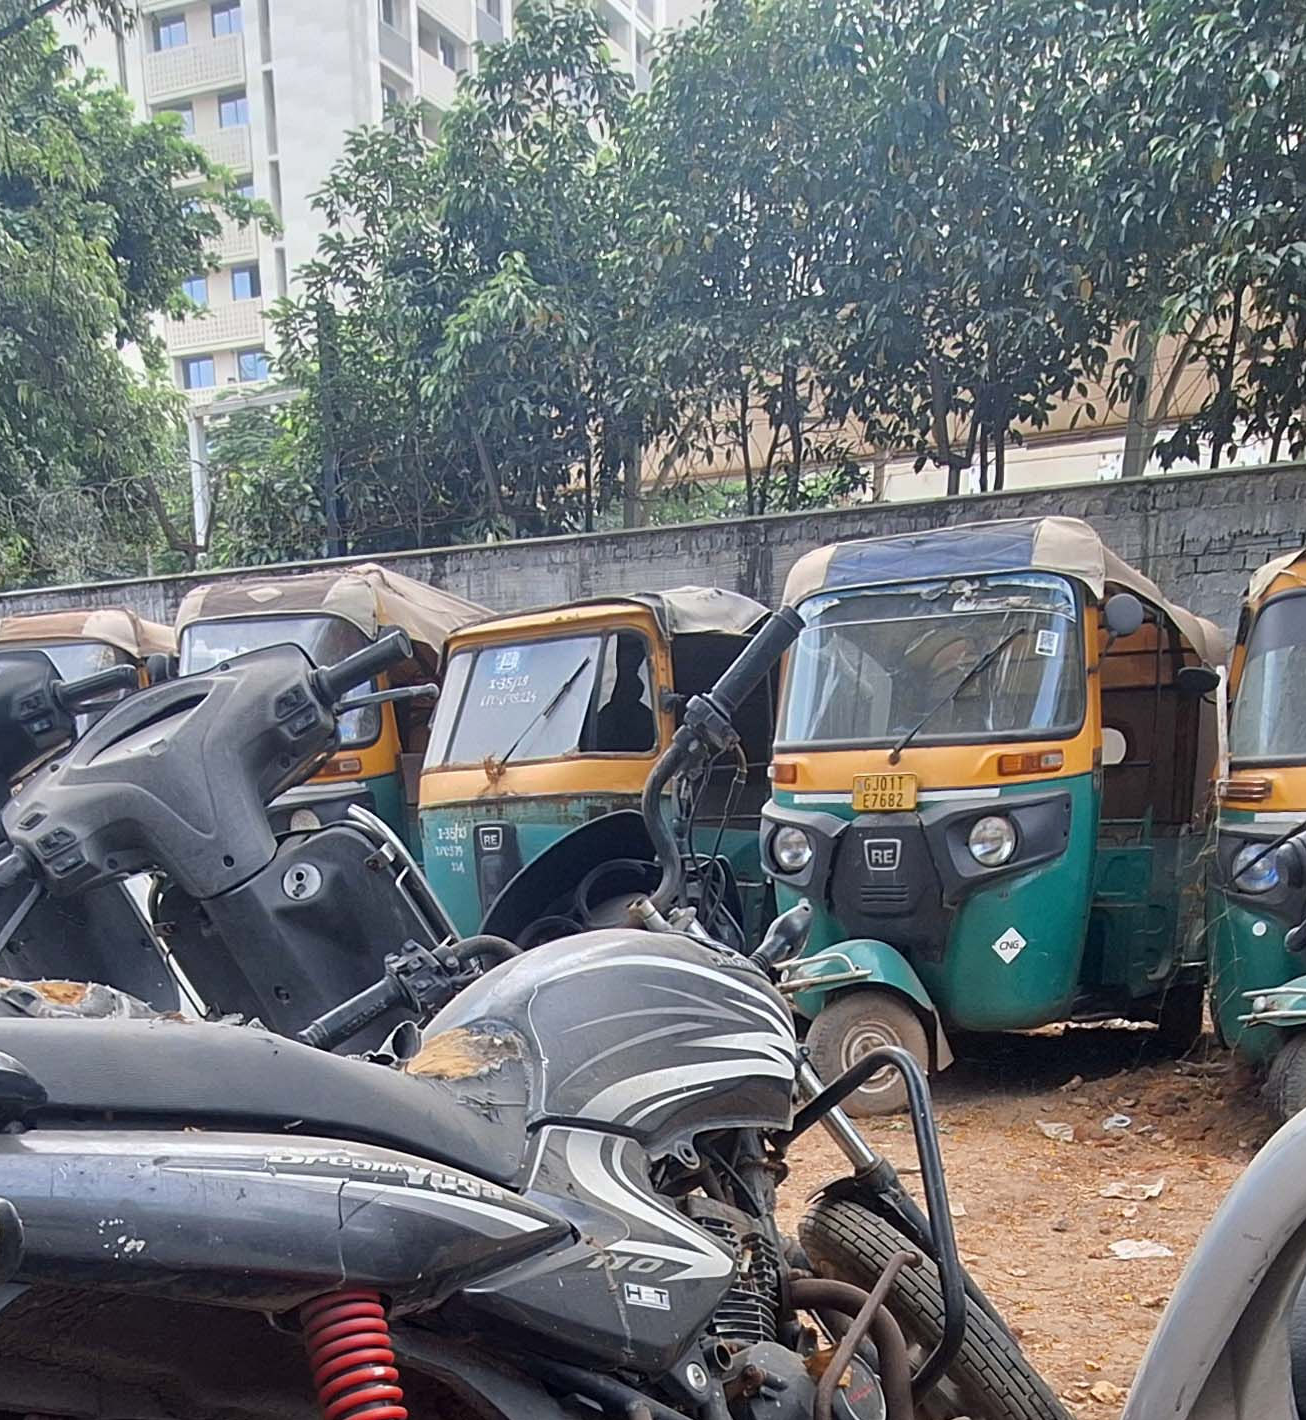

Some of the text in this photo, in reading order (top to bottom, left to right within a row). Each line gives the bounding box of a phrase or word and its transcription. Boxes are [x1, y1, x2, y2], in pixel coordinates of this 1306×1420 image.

[863, 776, 904, 792] GJ01T
[862, 793, 904, 808] E7682
[483, 834, 498, 846] RE
[871, 849, 894, 865] RE
[999, 940, 1020, 951] CNG
[267, 1153, 505, 1199] Dream Yuga
